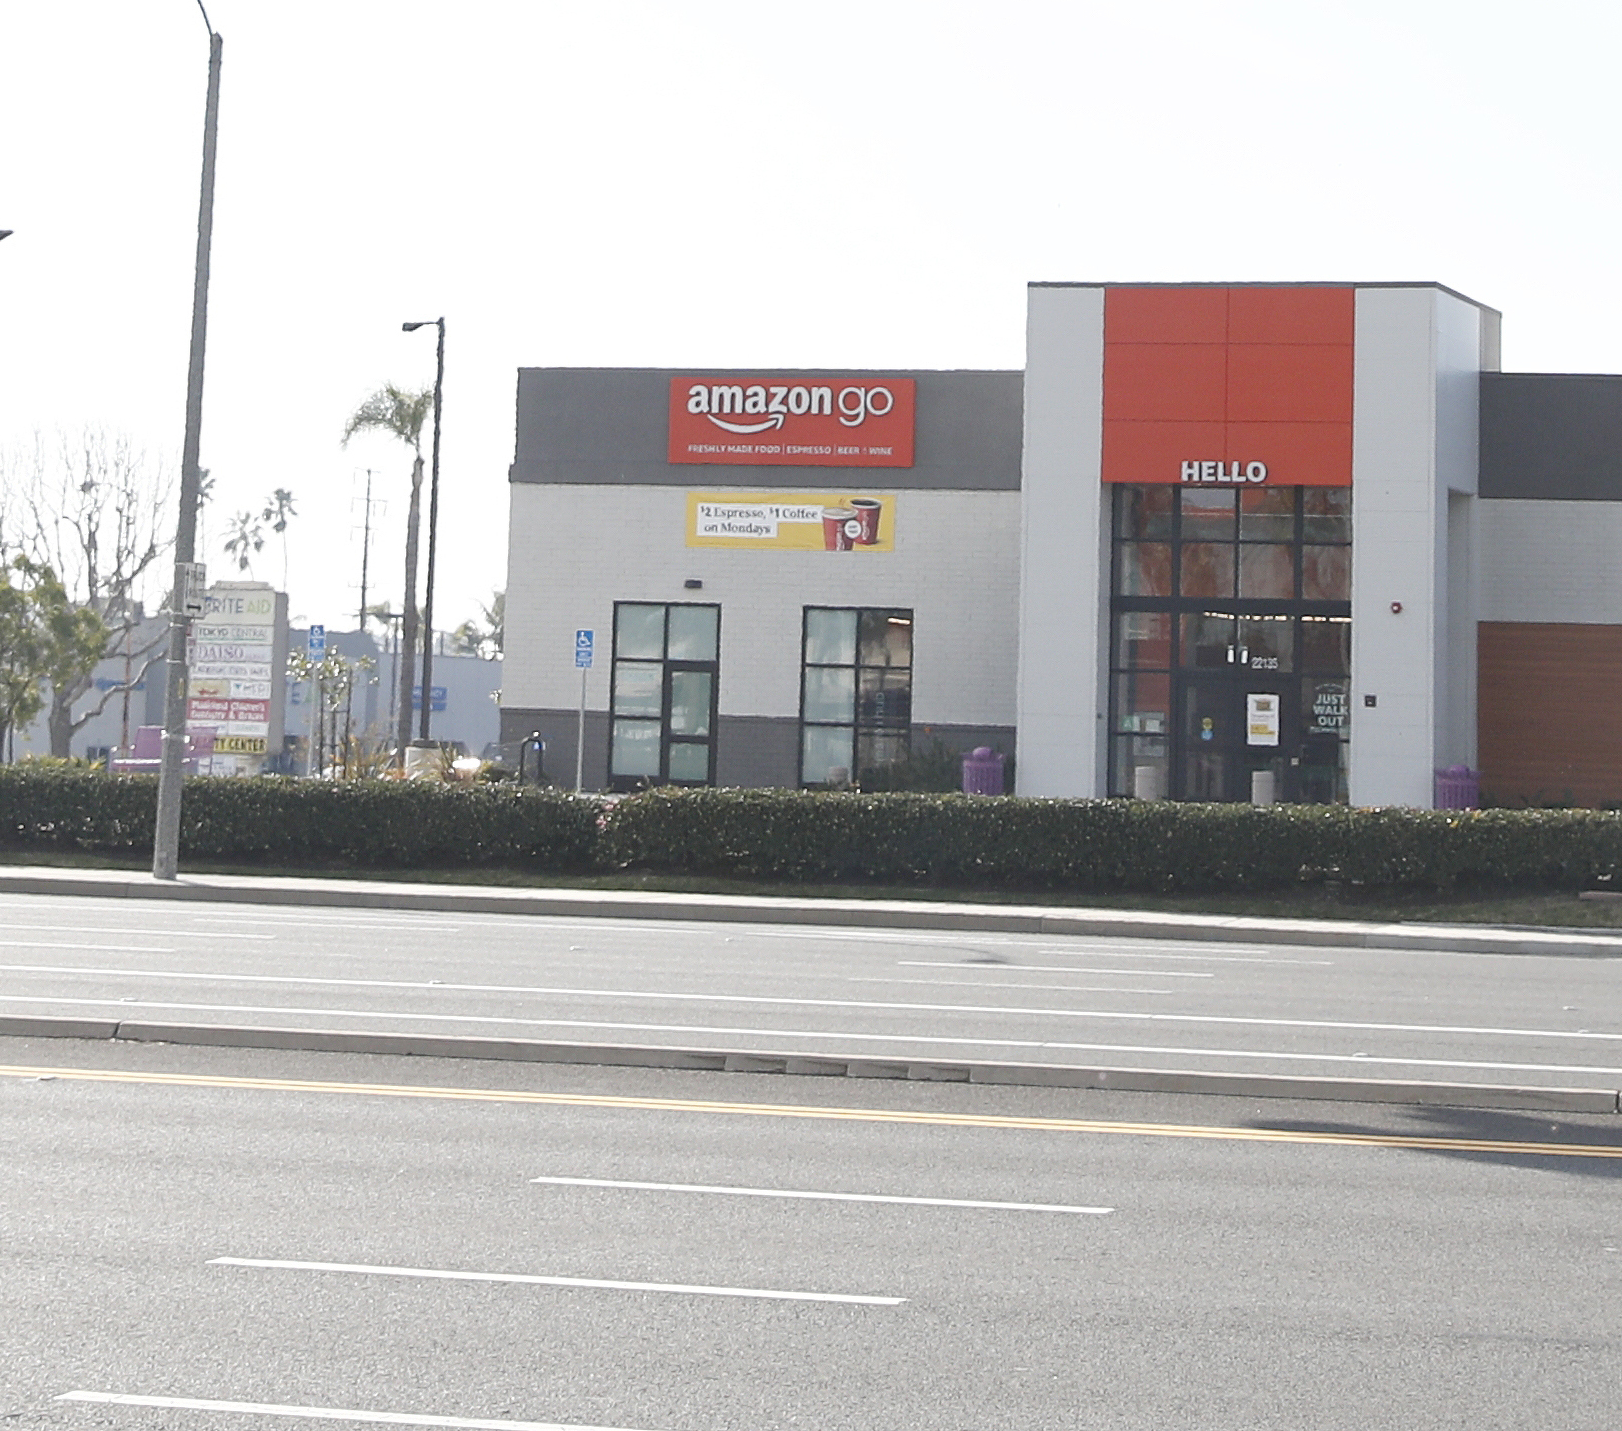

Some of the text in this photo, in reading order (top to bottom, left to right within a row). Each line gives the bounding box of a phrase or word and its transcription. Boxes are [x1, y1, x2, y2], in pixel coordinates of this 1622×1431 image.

[687, 384, 894, 427] amazon go
[687, 444, 726, 454] FRESHLY
[728, 445, 753, 454] MADE
[755, 445, 781, 455] FOOD
[786, 446, 832, 455] ESPRESSO
[837, 447, 860, 455] BEER
[869, 447, 893, 456] WINE
[1181, 460, 1267, 483] HELLO
[700, 505, 819, 519] $2 Espresso, $1 Coffee
[704, 522, 772, 535] on Mondays
[212, 598, 271, 614] RITE AID
[199, 646, 244, 659] DAISO
[1316, 693, 1346, 704] JUST
[1312, 704, 1348, 715] WALK
[1317, 715, 1345, 726] OUT
[229, 738, 265, 751] CENTER
